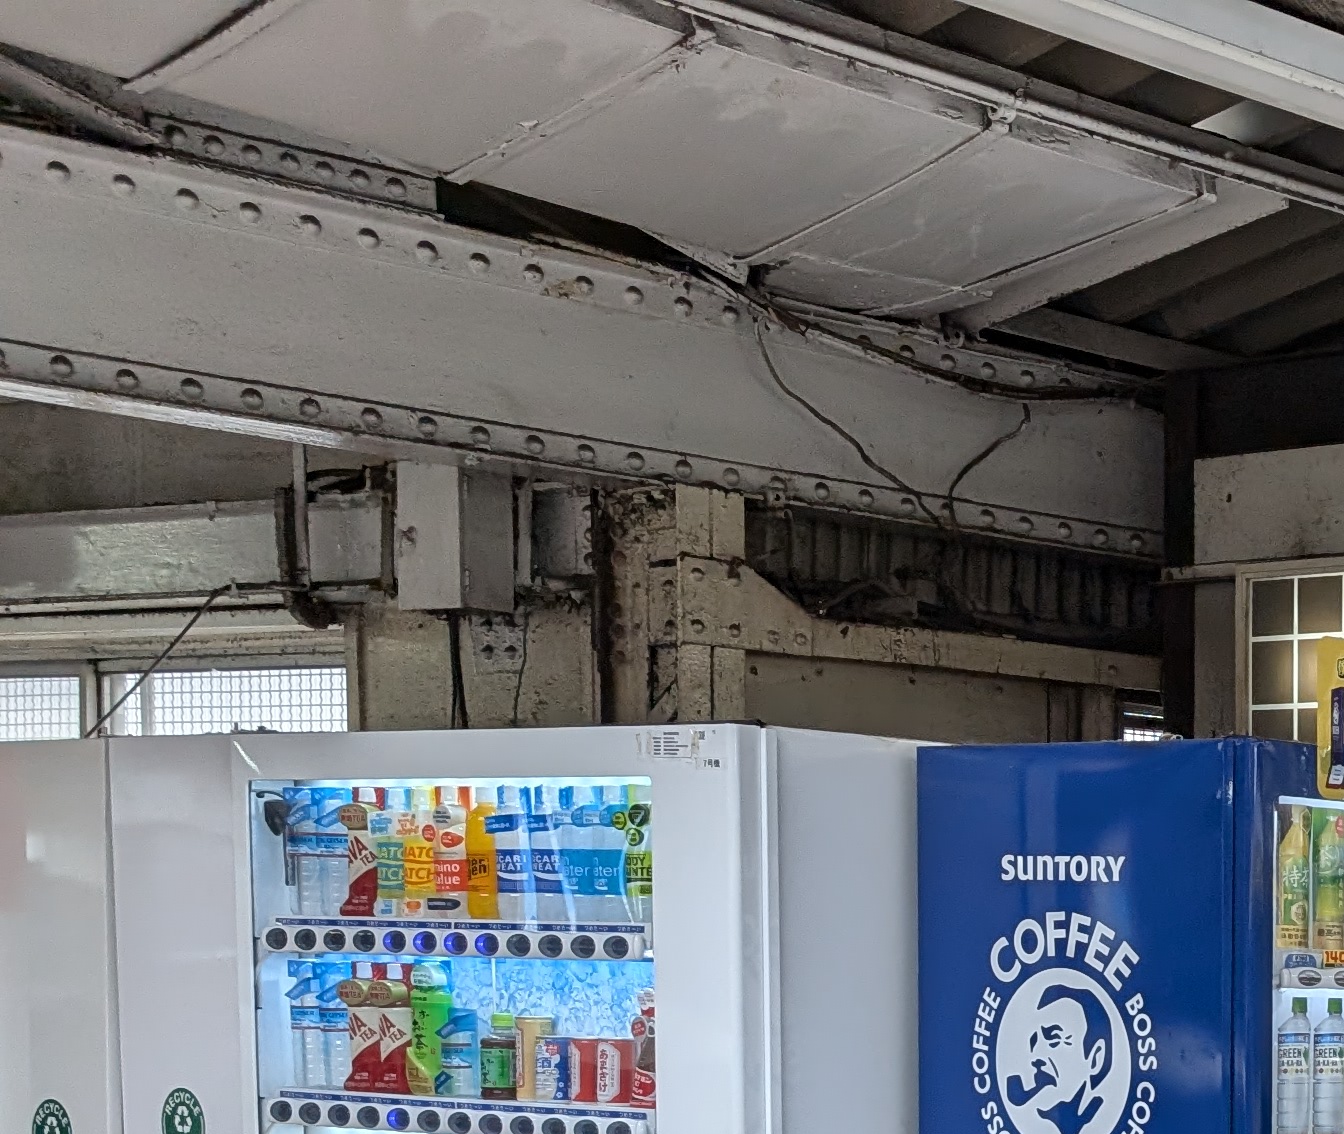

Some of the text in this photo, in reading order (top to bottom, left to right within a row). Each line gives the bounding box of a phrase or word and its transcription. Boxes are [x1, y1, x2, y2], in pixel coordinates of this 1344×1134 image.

[1001, 854, 1125, 883] SUNTORY
[990, 911, 1140, 991] COFFEE
[972, 986, 1002, 1095] COFFEE
[1124, 991, 1158, 1071] BOSS
[35, 1102, 69, 1127] RECYCLE
[165, 1091, 201, 1116] RECYCLE
